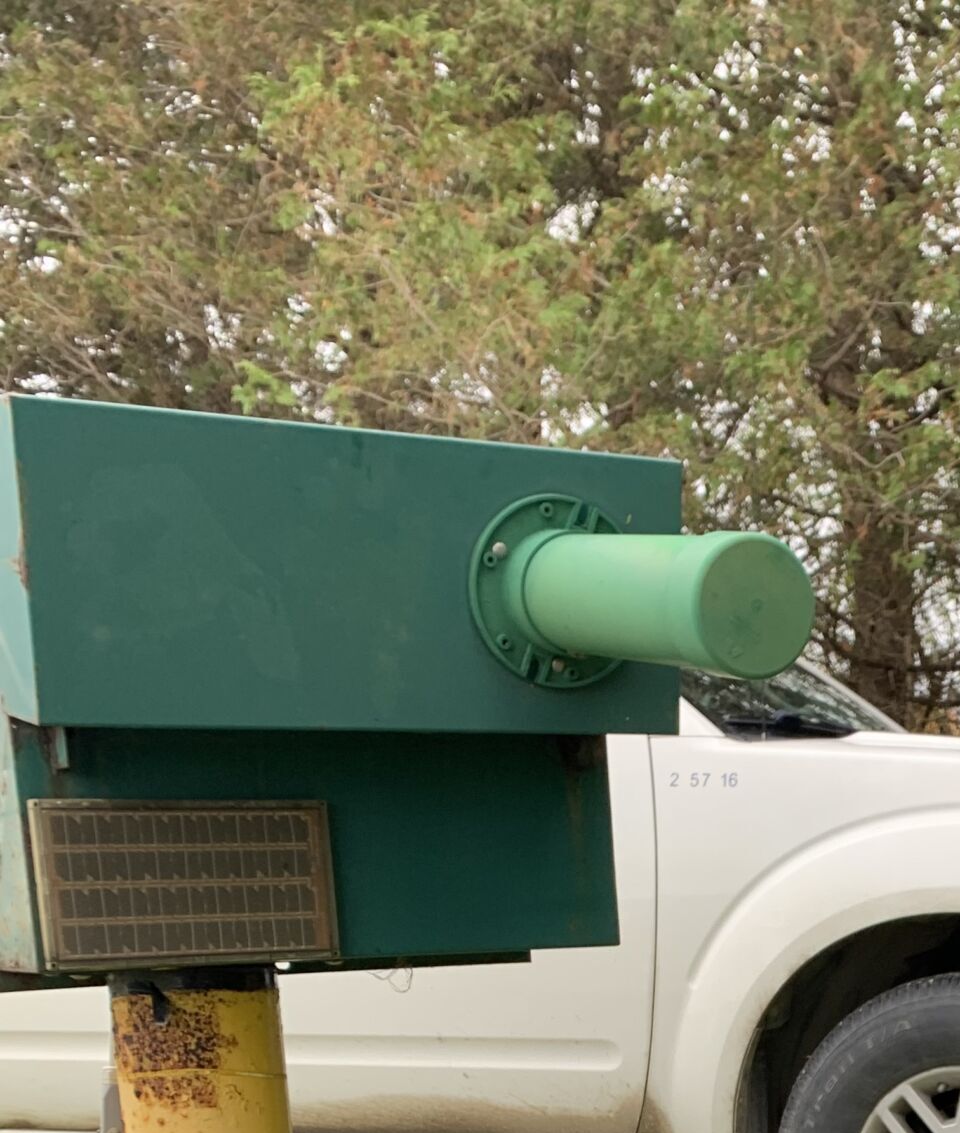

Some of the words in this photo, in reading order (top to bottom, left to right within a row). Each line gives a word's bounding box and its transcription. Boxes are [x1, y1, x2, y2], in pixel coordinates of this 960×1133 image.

[669, 772, 680, 788] 2
[690, 772, 711, 788] 57
[721, 772, 739, 788] 16
